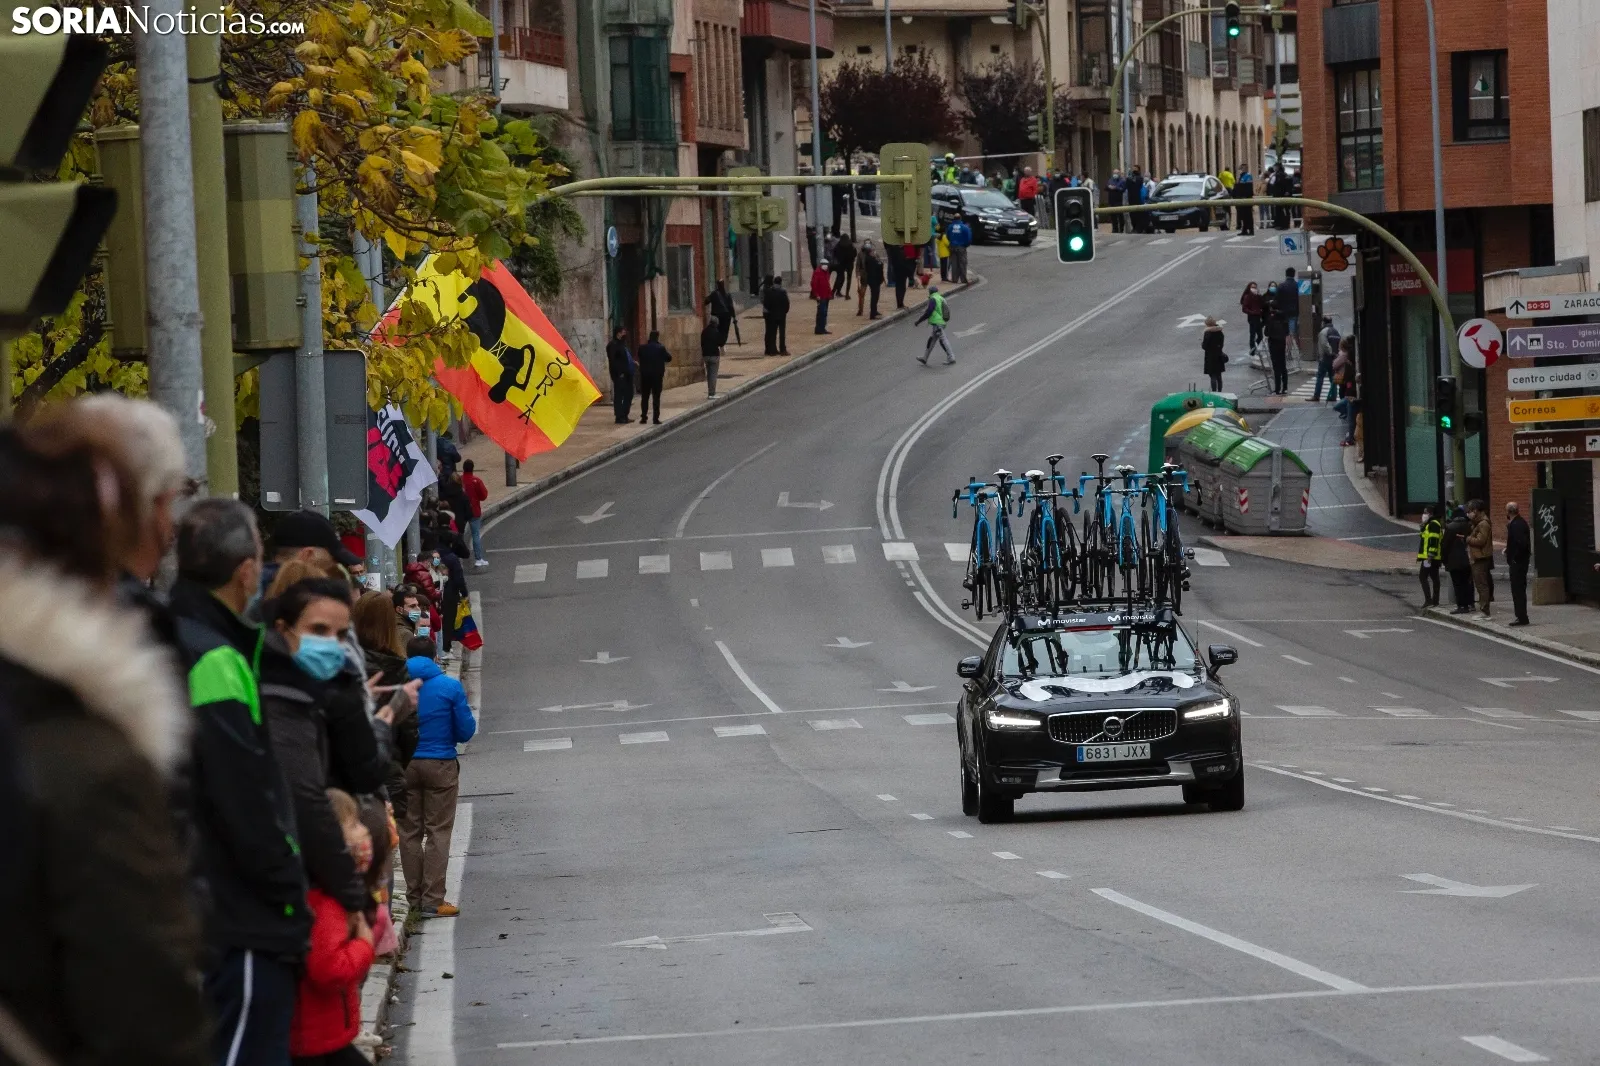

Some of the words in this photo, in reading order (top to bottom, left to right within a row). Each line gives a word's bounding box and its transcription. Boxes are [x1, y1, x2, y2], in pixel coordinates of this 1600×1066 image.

[1579, 329, 1600, 337] iglesi
[1546, 340, 1568, 349] Sto.
[1512, 375, 1545, 384] centro
[1549, 372, 1582, 382] ciudad
[517, 349, 571, 425] SORIA
[1513, 406, 1556, 415] Correos
[1516, 438, 1542, 446] parque
[1517, 447, 1529, 455] La
[1534, 444, 1577, 454] Alameda
[1086, 747, 1117, 760] 6831
[1123, 745, 1147, 758] JXX
